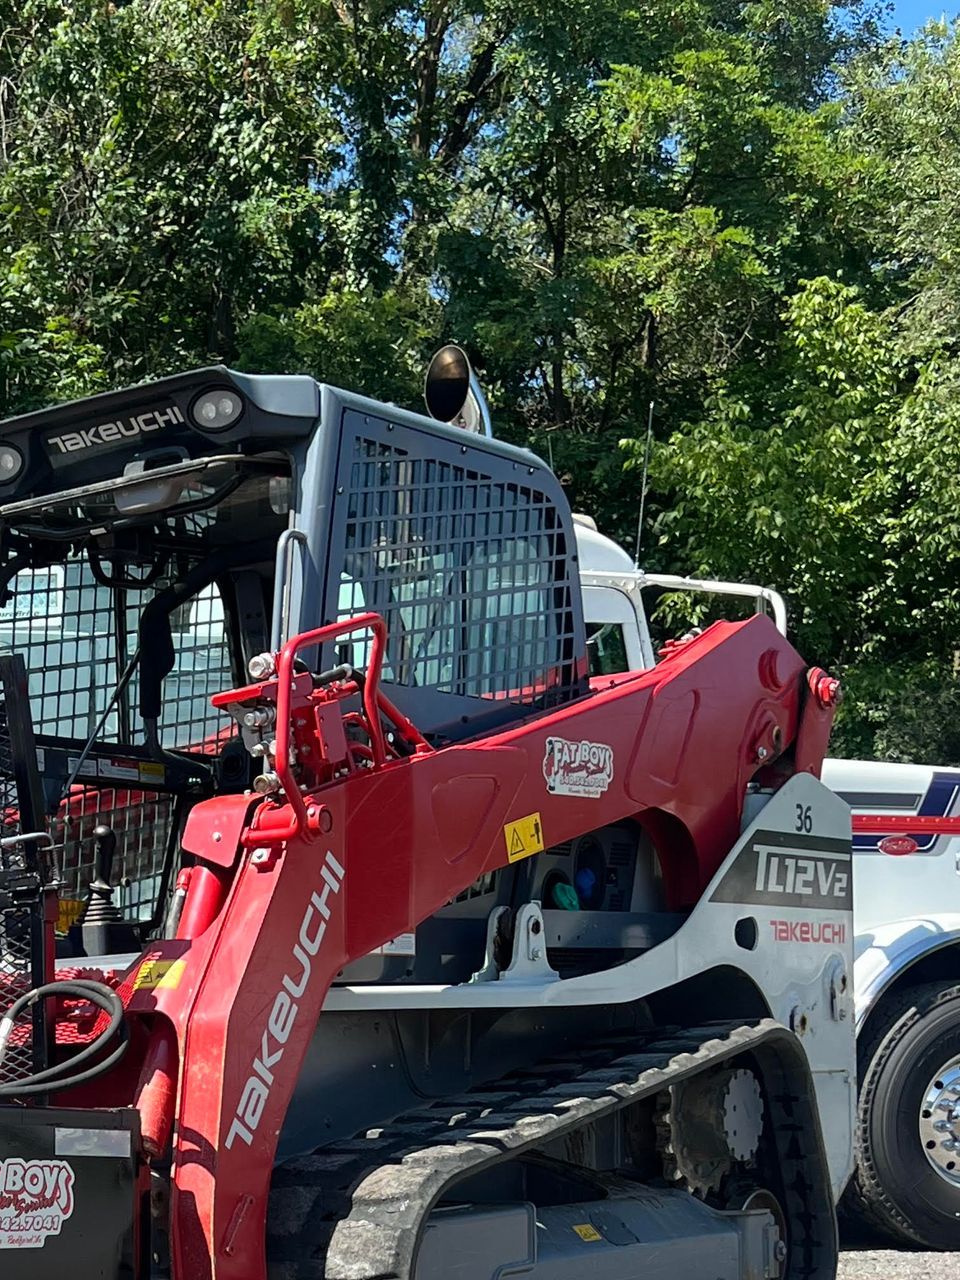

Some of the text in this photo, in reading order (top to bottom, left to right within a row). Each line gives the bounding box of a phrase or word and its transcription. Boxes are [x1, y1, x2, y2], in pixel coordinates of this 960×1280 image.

[553, 741, 581, 775] FAT
[580, 743, 612, 779] BOYS
[795, 803, 813, 833] 36
[752, 844, 851, 897] TL12V2
[4, 1163, 72, 1216] BOYS
